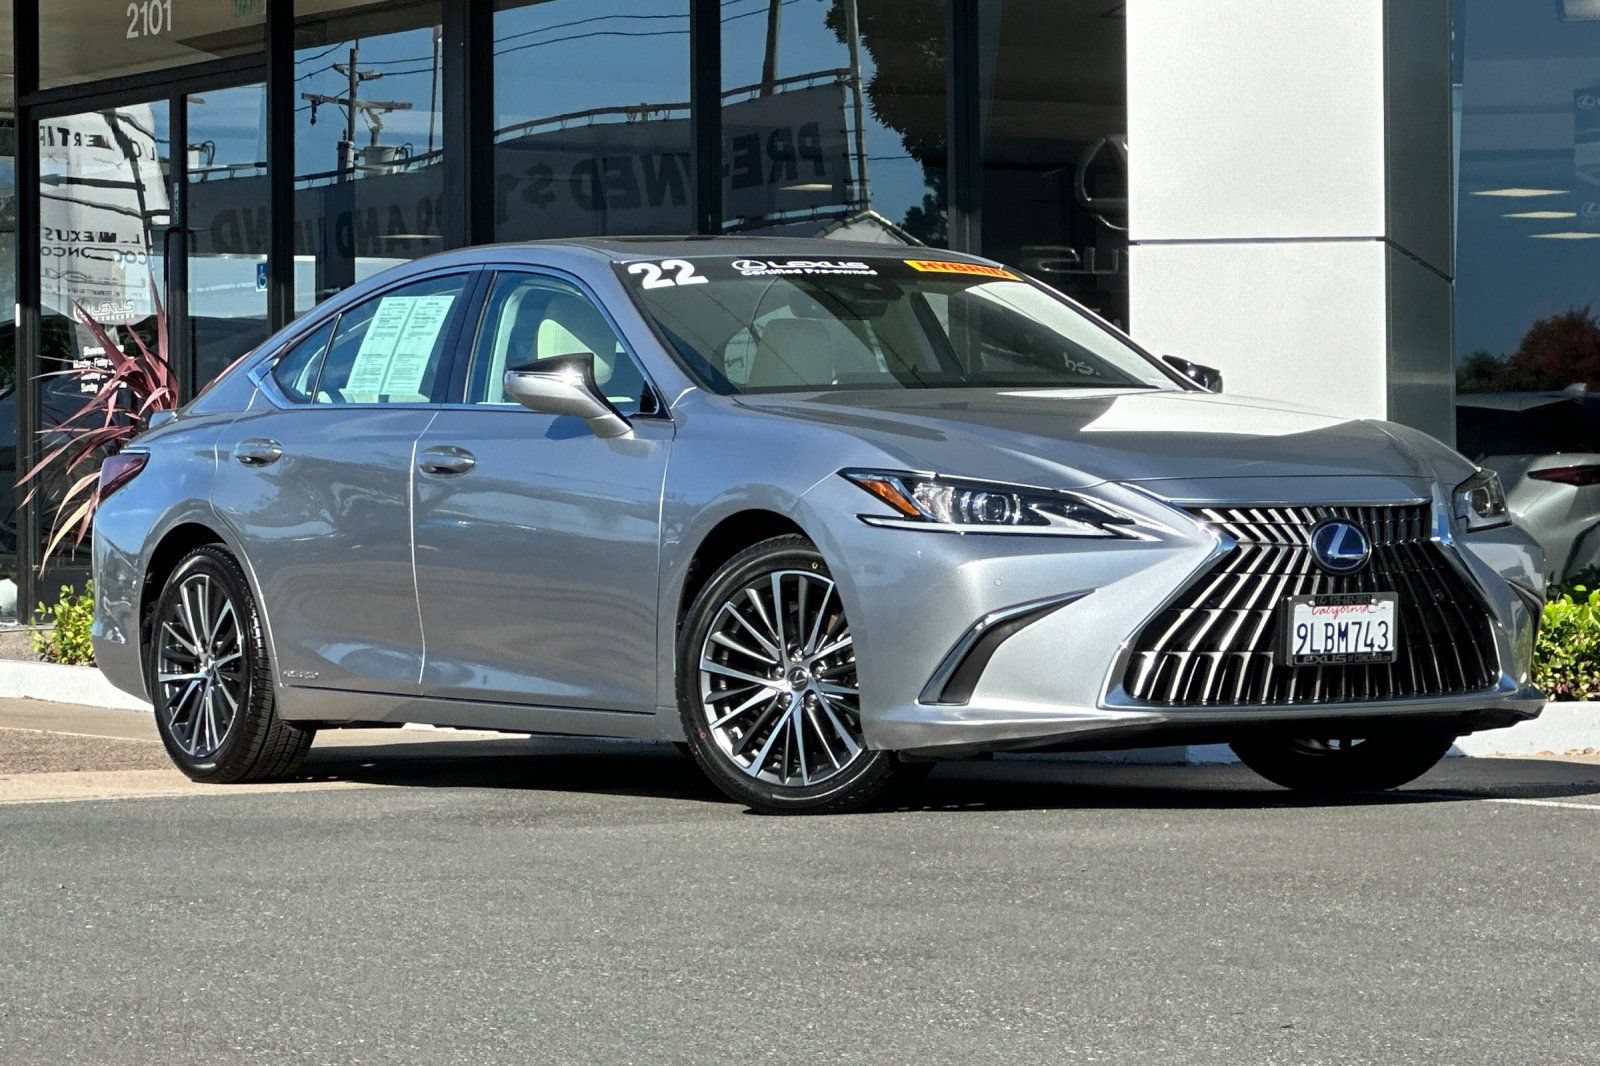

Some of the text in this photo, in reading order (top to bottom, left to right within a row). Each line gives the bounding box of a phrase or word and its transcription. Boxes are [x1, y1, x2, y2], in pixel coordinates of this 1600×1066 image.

[126, 0, 172, 39] 2101
[628, 260, 709, 289] 22
[767, 261, 870, 269] LEXUS
[1311, 605, 1371, 619] California
[1296, 621, 1388, 654] 9LBM743
